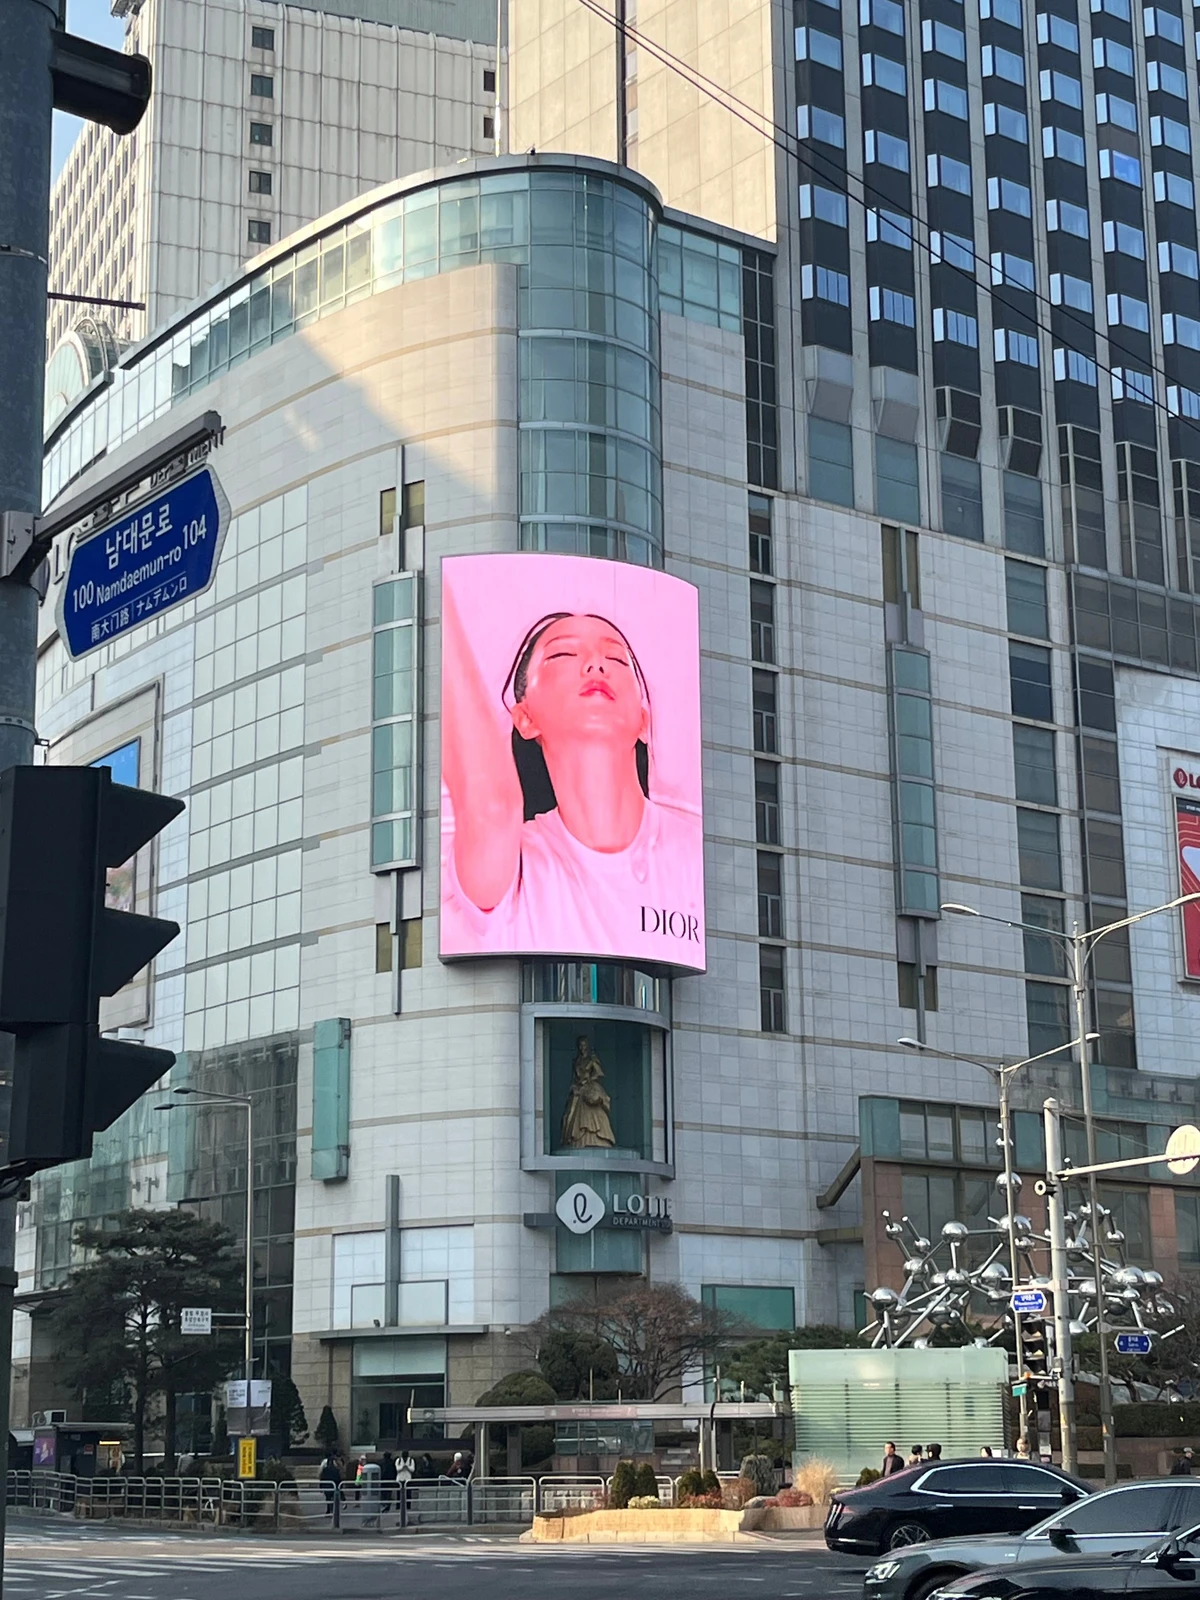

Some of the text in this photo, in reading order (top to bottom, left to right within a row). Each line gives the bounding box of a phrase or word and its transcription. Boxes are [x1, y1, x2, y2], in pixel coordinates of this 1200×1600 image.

[105, 503, 173, 570] 남대문로
[72, 514, 207, 613] 100 Namdaemun-ro 104
[90, 607, 130, 643] 南大门路
[640, 905, 700, 944] DIOR
